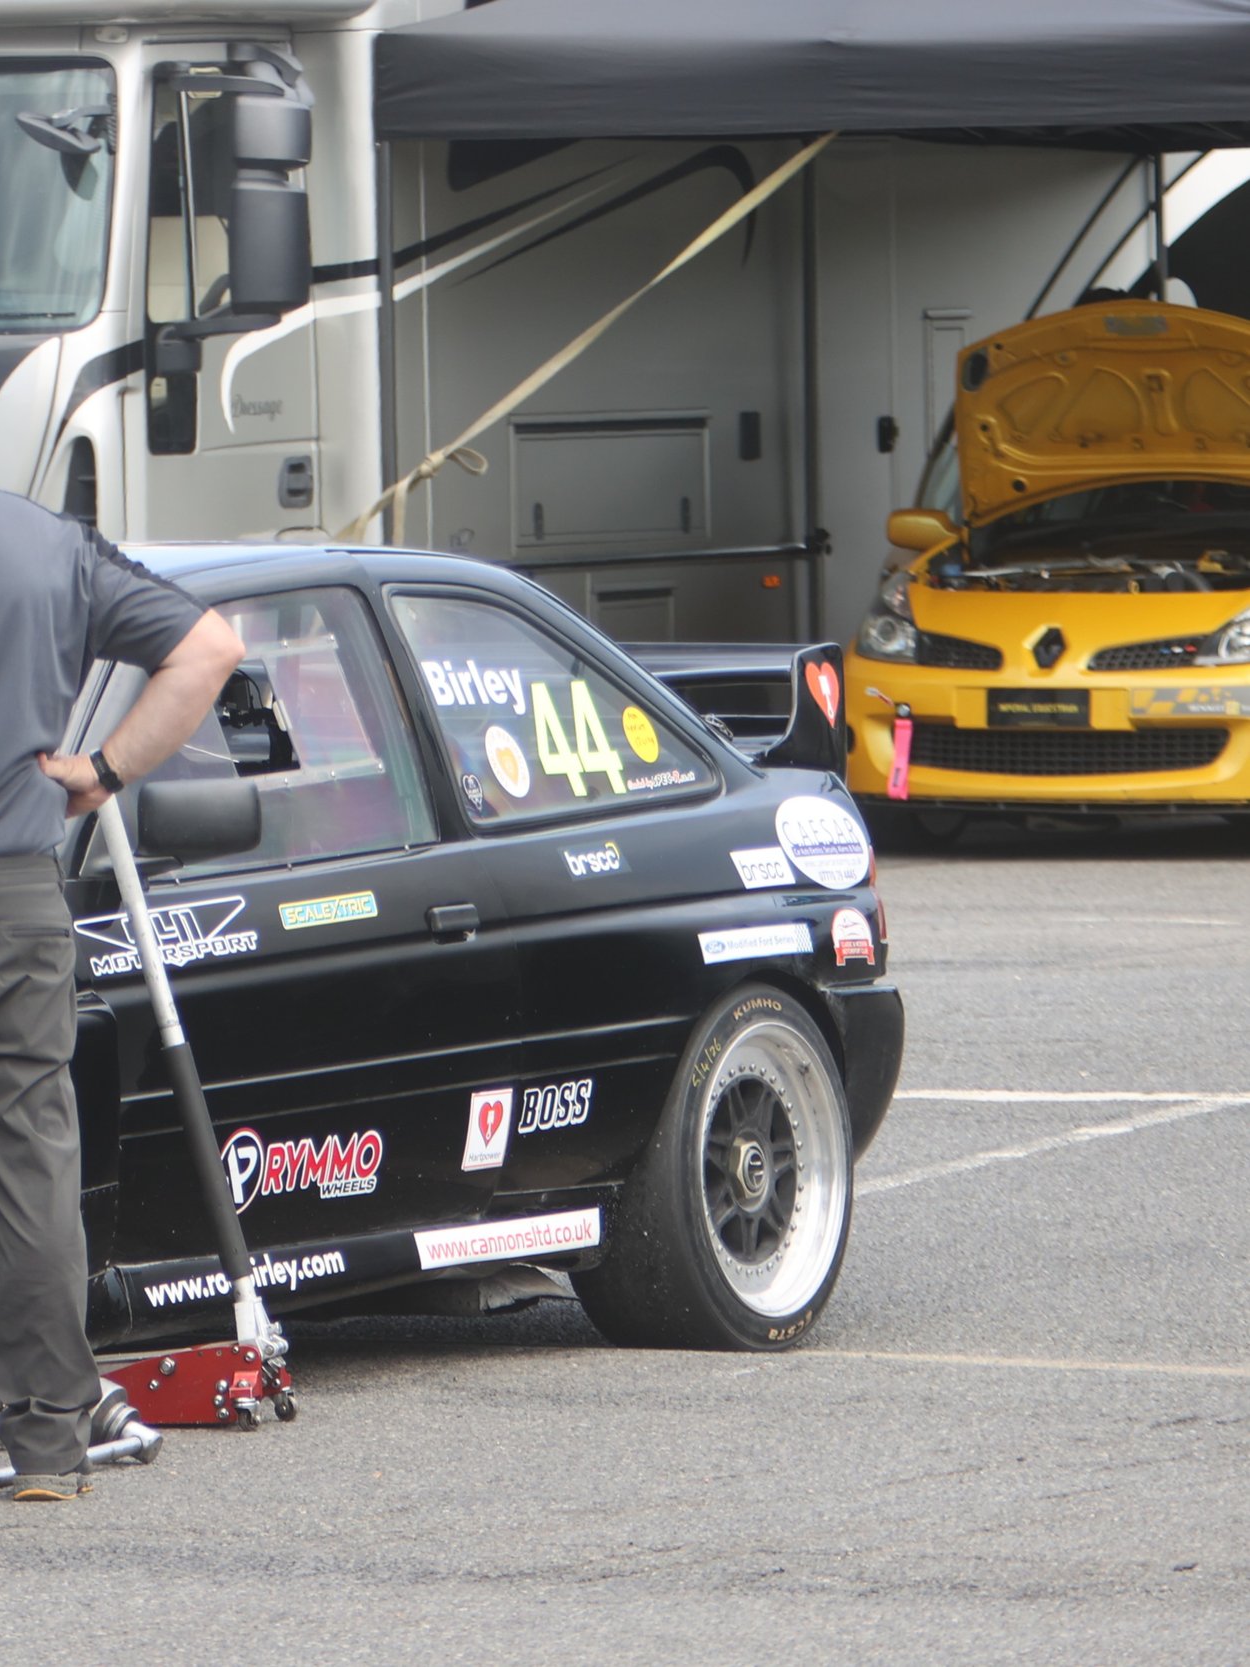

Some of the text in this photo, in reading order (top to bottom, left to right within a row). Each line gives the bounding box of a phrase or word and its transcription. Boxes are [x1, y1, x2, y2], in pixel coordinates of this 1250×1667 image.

[421, 659, 526, 715] Birley
[530, 680, 627, 796] 44
[782, 818, 861, 847] CAESAR
[563, 845, 620, 877] brscc
[739, 857, 786, 882] brscc
[285, 893, 373, 924] SCALEXTRIC
[90, 931, 258, 977] MOTRSPORT
[733, 998, 782, 1021] KUMHO
[518, 1079, 593, 1134] BOSS
[426, 1217, 593, 1262] www.cannonsltd.co.uk
[144, 1249, 346, 1308] www.roirley.com
